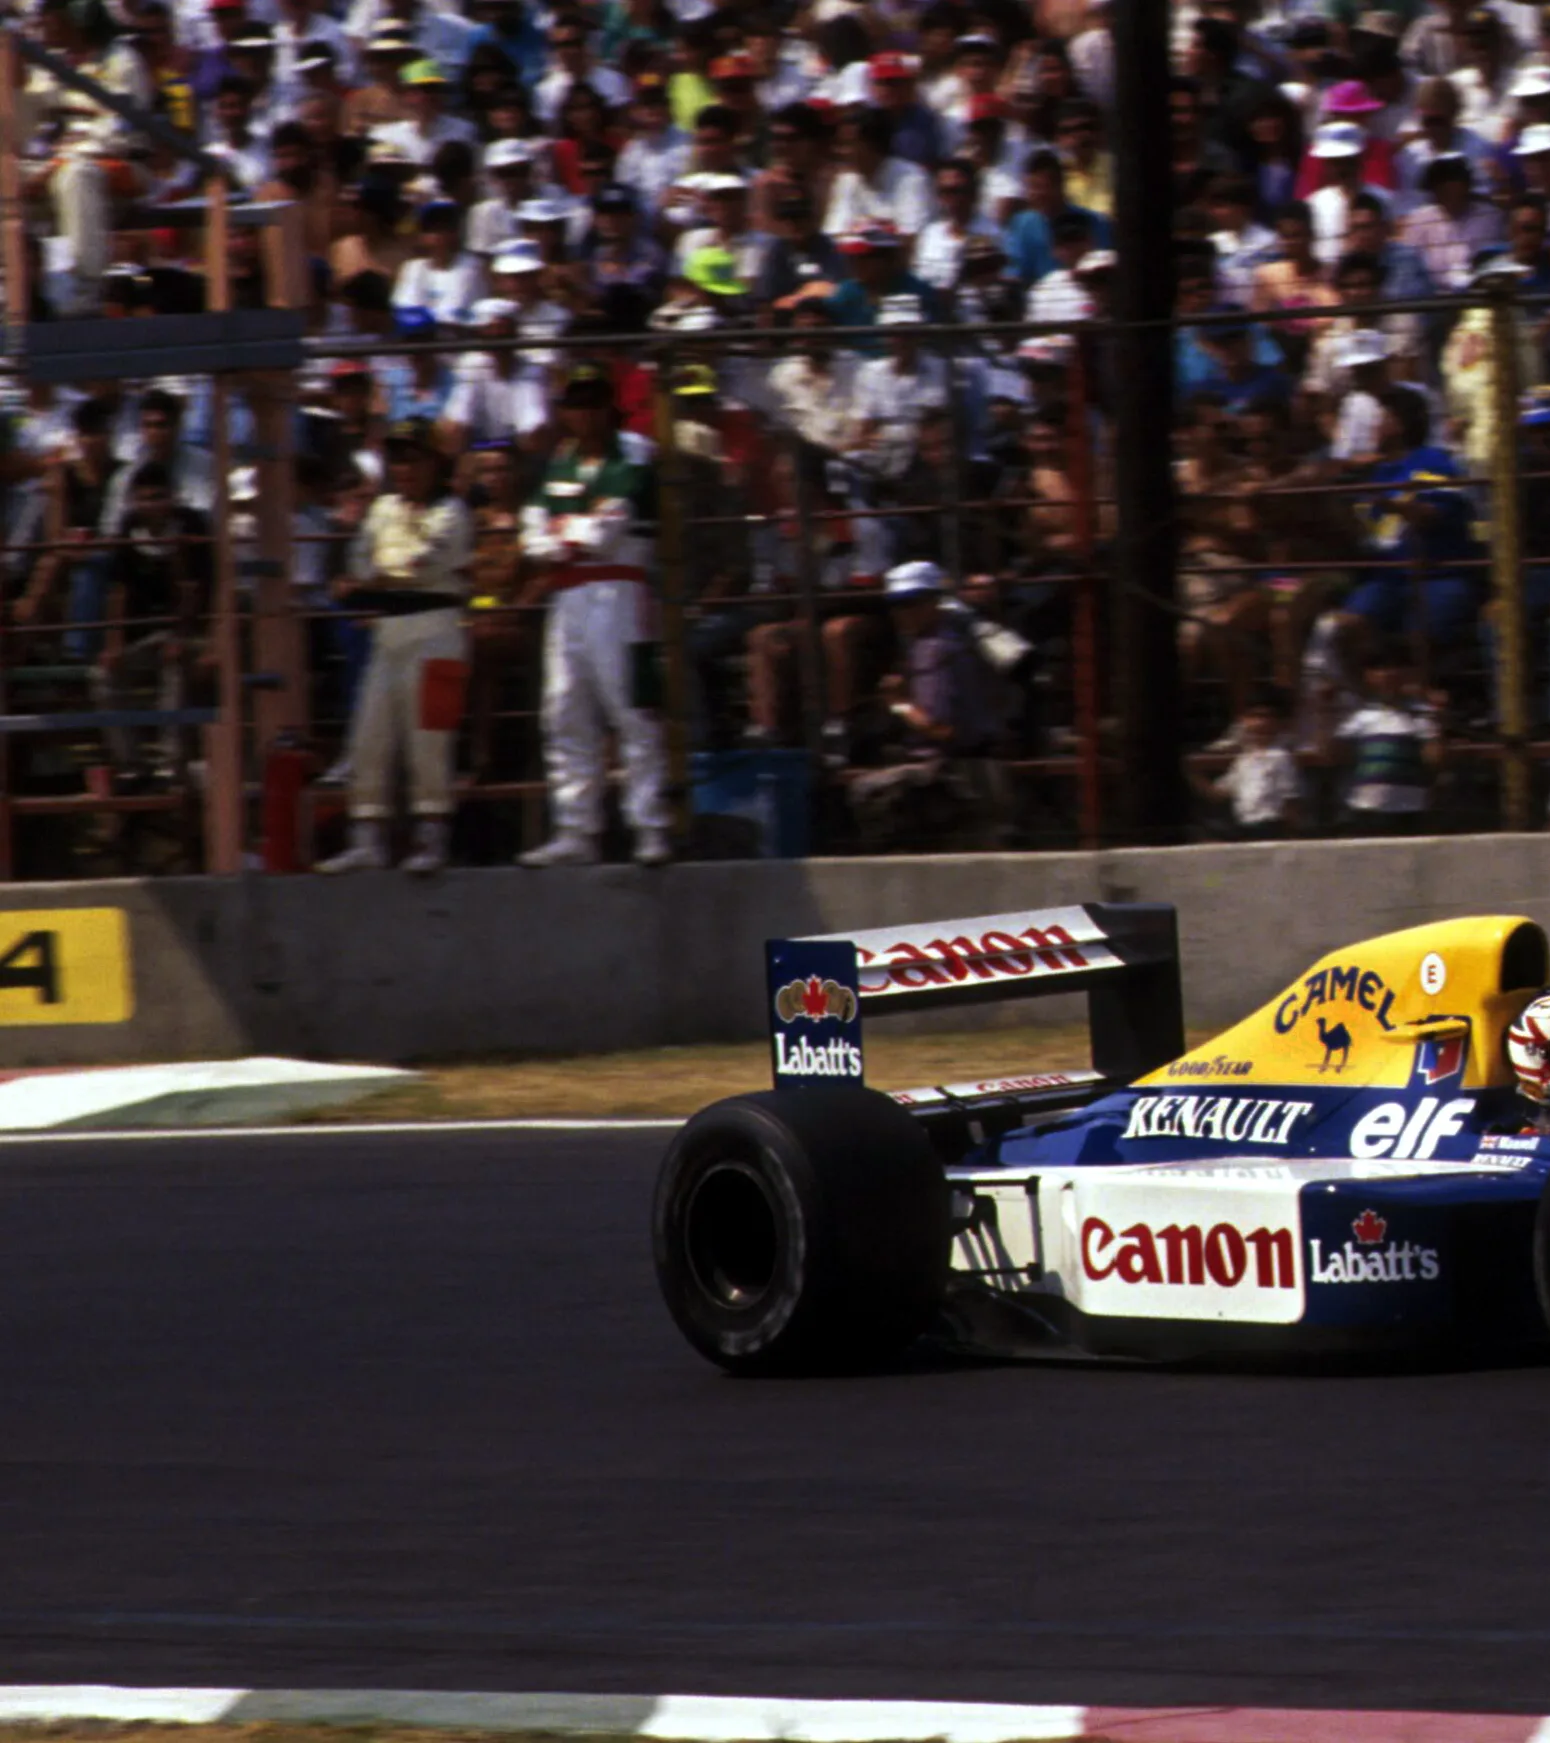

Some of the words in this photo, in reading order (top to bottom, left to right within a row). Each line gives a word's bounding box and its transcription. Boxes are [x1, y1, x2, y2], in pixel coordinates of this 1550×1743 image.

[857, 924, 1089, 993] Canon
[1426, 963, 1438, 986] E
[1274, 965, 1398, 1034] CAMEL
[774, 1032, 862, 1076] Labatt's
[976, 1074, 1071, 1092] Canon
[1121, 1096, 1313, 1144] RENAULT
[1349, 1099, 1476, 1159] elf
[1080, 1216, 1296, 1289] Canon
[1310, 1238, 1439, 1284] Labatt's
